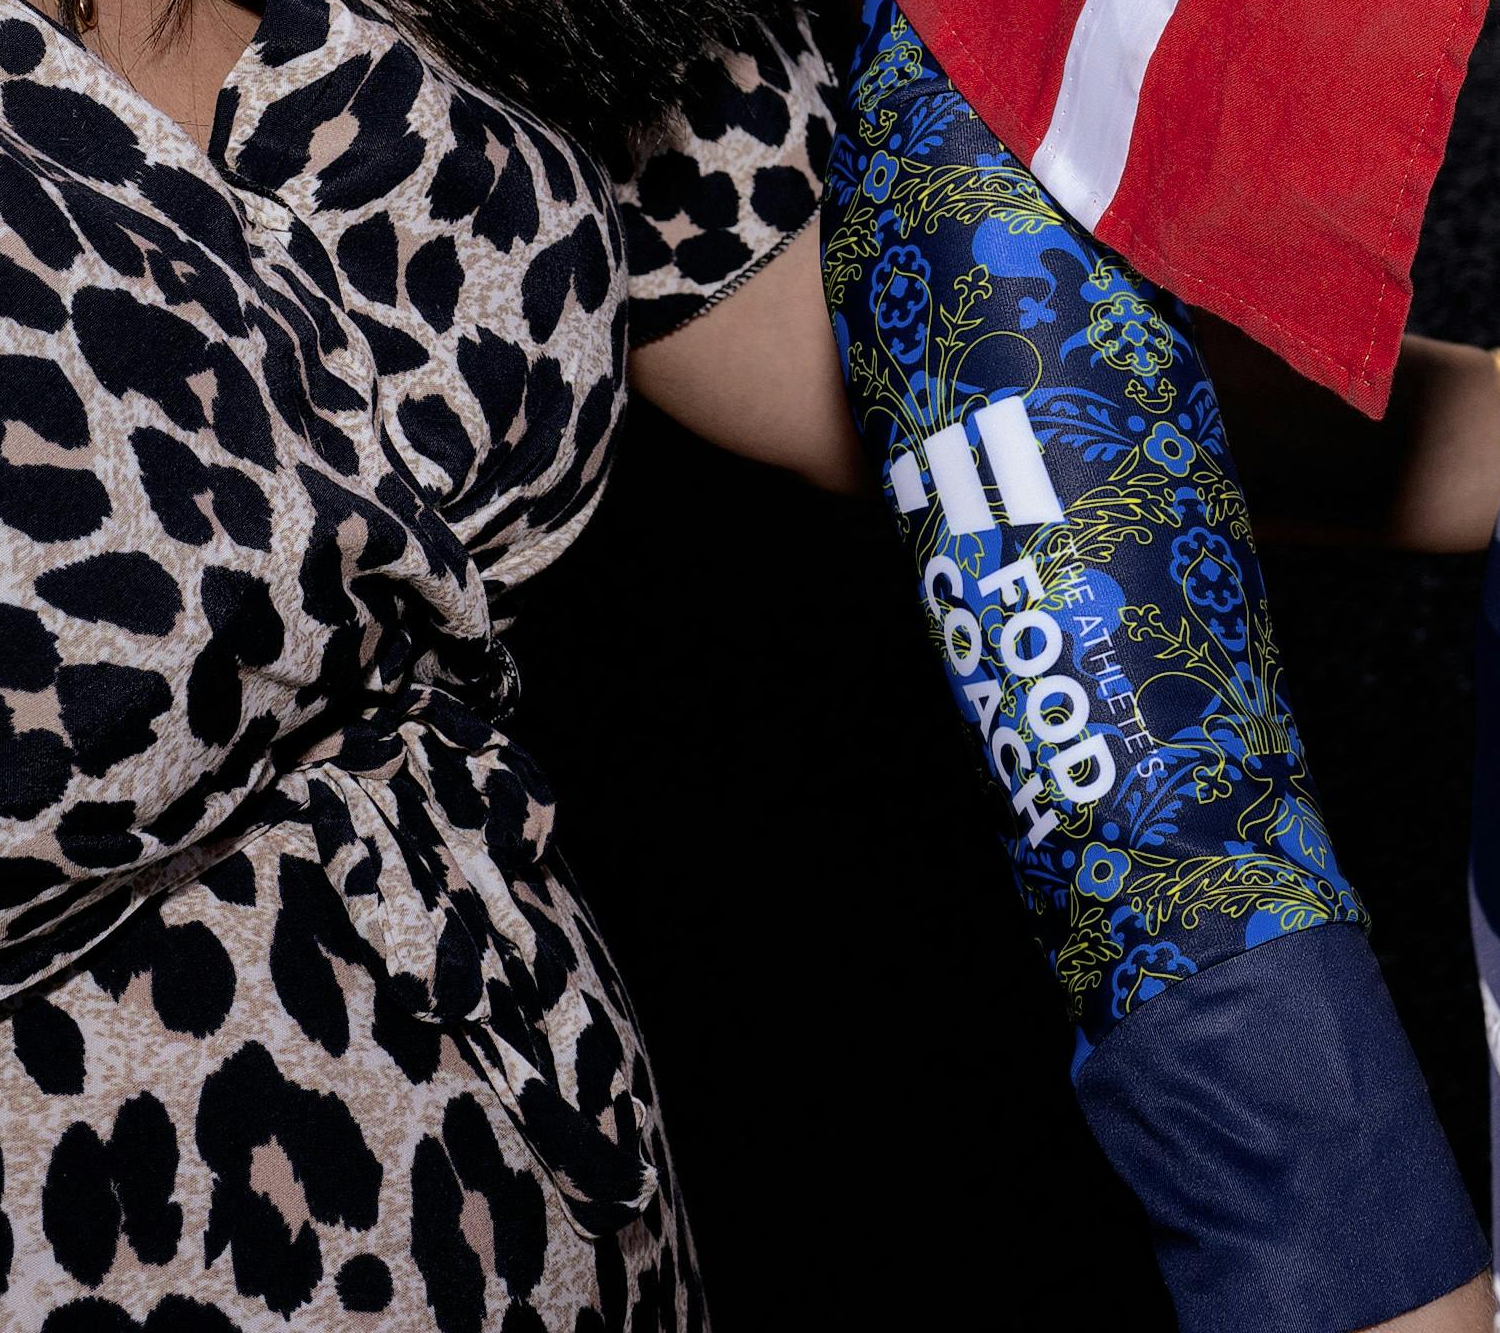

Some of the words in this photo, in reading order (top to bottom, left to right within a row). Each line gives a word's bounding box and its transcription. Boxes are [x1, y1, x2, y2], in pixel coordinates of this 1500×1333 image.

[977, 557, 1117, 805] FOOD
[1055, 541, 1095, 610] THE
[926, 556, 1058, 849] COACH
